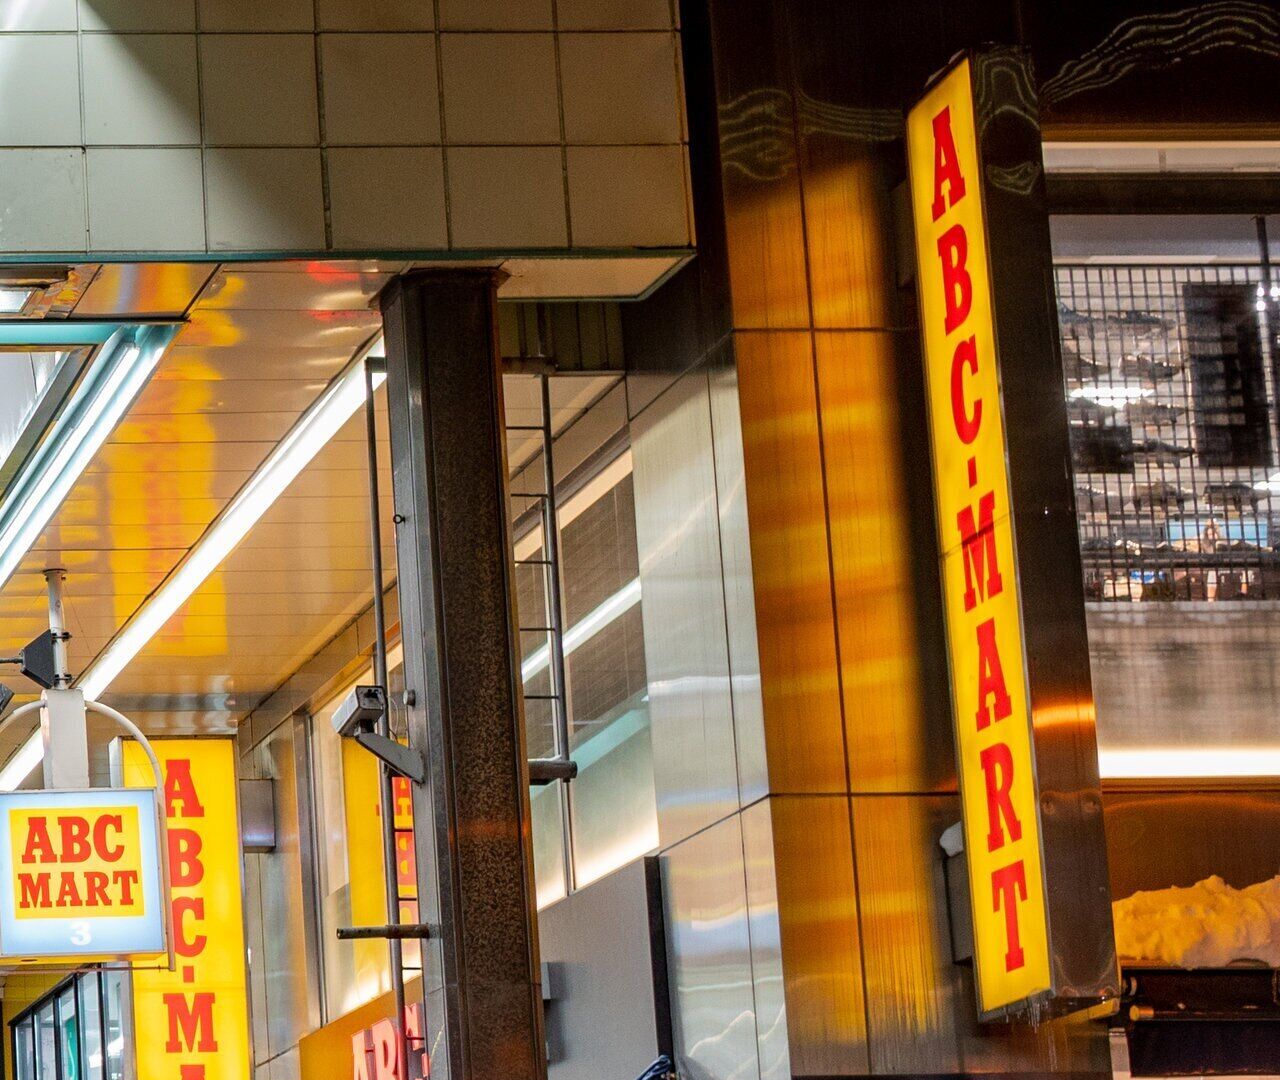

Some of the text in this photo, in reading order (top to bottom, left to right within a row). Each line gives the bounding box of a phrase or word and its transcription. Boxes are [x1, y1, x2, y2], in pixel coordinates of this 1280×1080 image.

[22, 814, 124, 864] ABC
[17, 869, 139, 910] MART
[70, 919, 92, 946] 3
